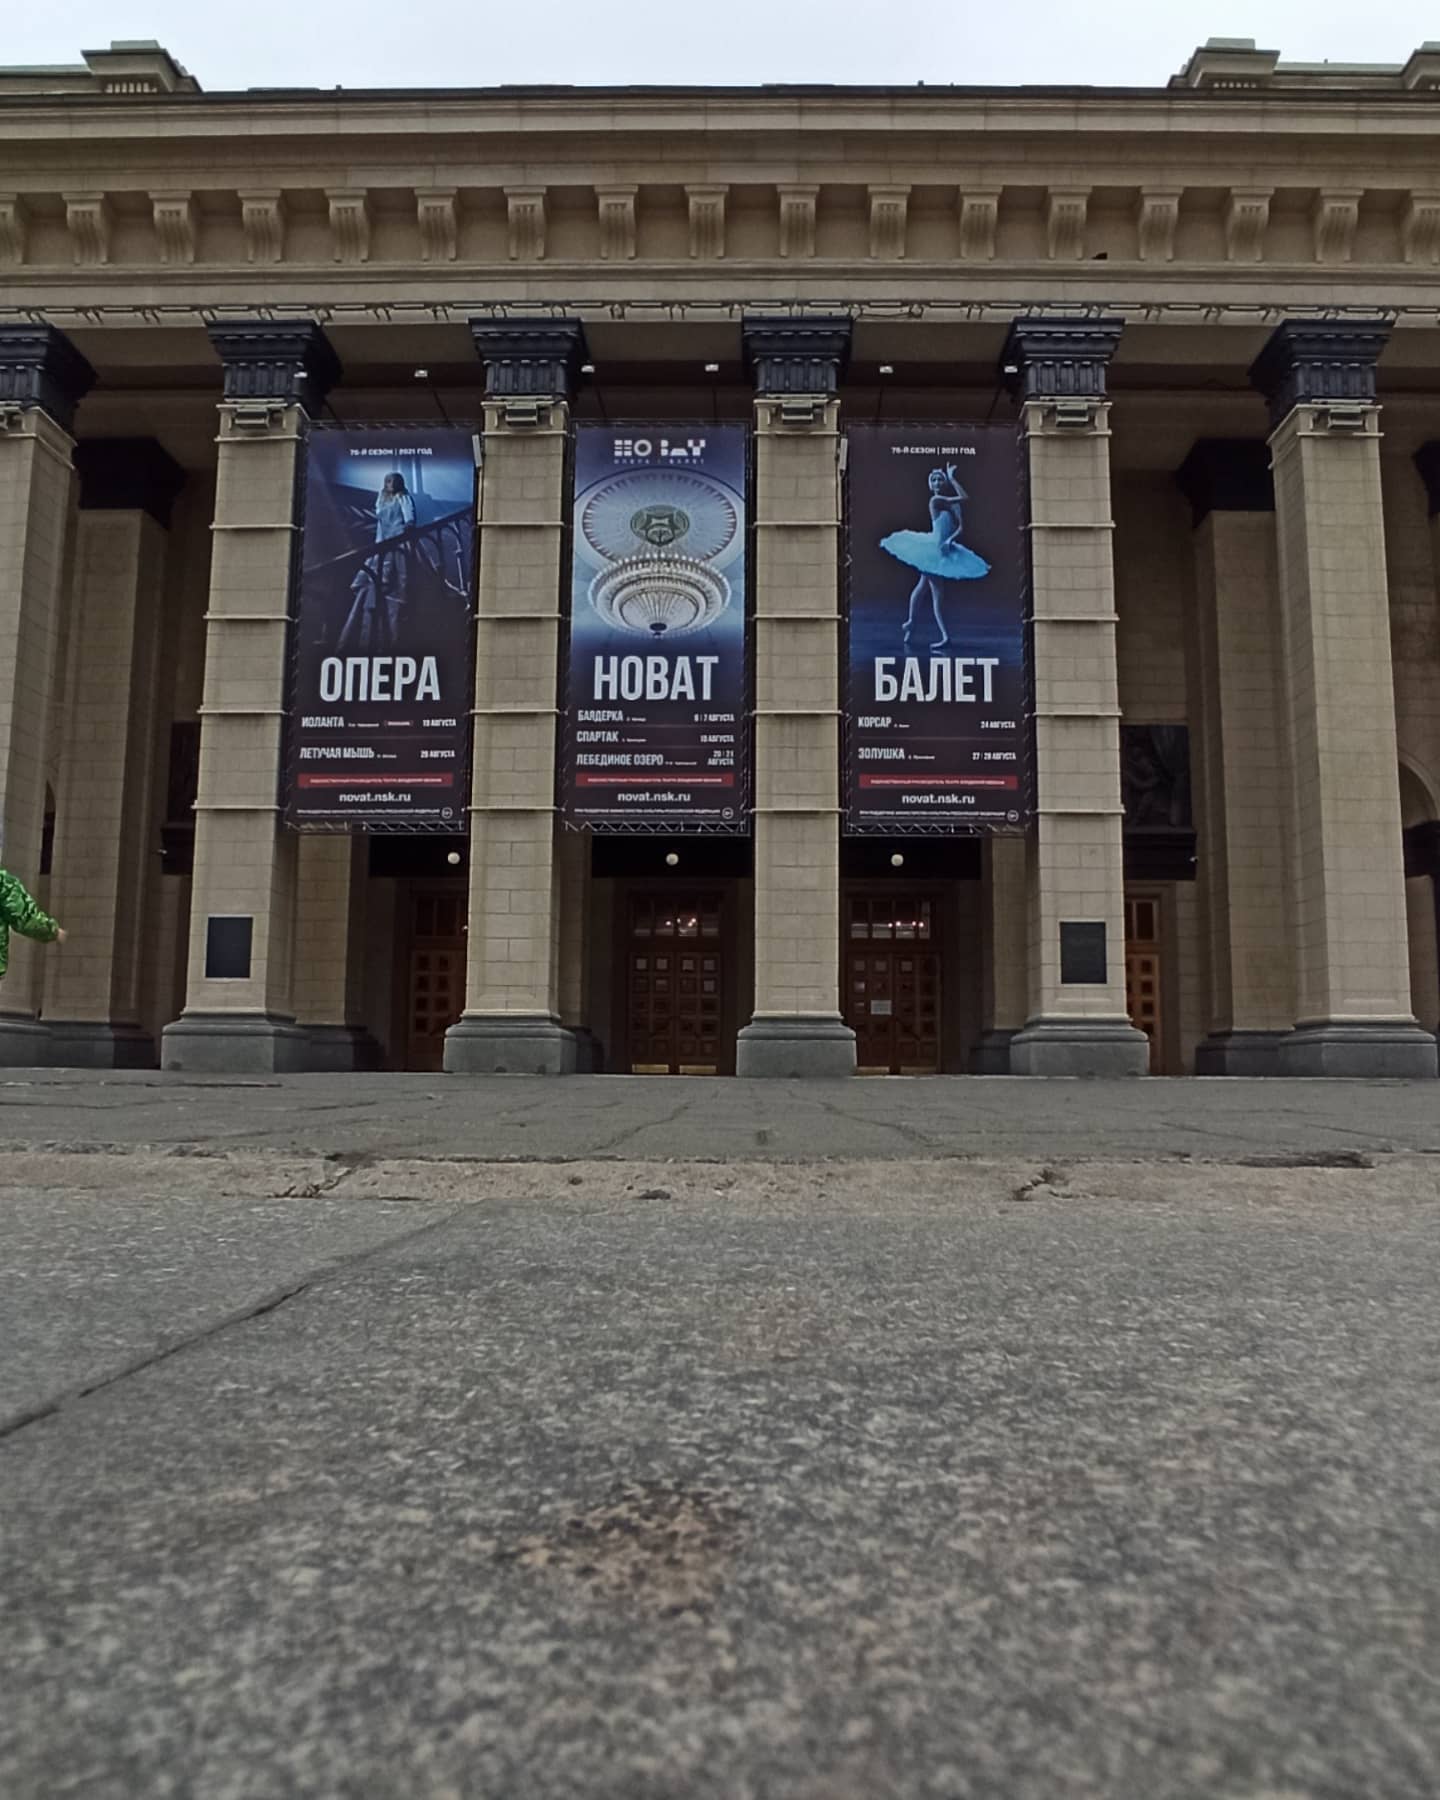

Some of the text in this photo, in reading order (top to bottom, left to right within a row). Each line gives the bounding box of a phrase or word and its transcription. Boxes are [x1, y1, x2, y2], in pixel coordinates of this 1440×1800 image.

[368, 448, 394, 456] СЕЗОН
[417, 447, 433, 456] ГОД
[910, 446, 936, 455] СЕЗОН
[941, 446, 958, 455] 2021
[959, 446, 976, 456] ГОД
[319, 655, 441, 703] ОПЕРА
[593, 655, 719, 701] НОВАТ
[874, 656, 1000, 702] БАЛЕТ
[300, 716, 345, 728] ИОЛАНТА
[431, 718, 457, 728] АВГУСТА
[577, 710, 623, 722] БАЯДЕРКА
[708, 713, 735, 722] АВГУСТА
[857, 716, 892, 728] КОРСАР
[989, 720, 1016, 729] АВГУСТА
[576, 730, 619, 743] СПАРТАК
[708, 734, 735, 743] АВГУСТА
[299, 747, 342, 760] ЛЕТУЧАЯ
[343, 747, 375, 759] МЫШЬ
[429, 750, 455, 759] АВГУСТА
[858, 747, 905, 760] ЗОЛУШКА
[992, 751, 1017, 761] АВГУСТА
[576, 754, 631, 766] ЛЕБЕДИНОЕ
[633, 754, 664, 766] ОЗЕРО
[707, 758, 735, 767] АВГУСТА
[339, 791, 411, 803] novat.nsk.ru
[618, 791, 691, 802] novat.nsk.ru
[902, 793, 975, 805] novat.nsk.ru
